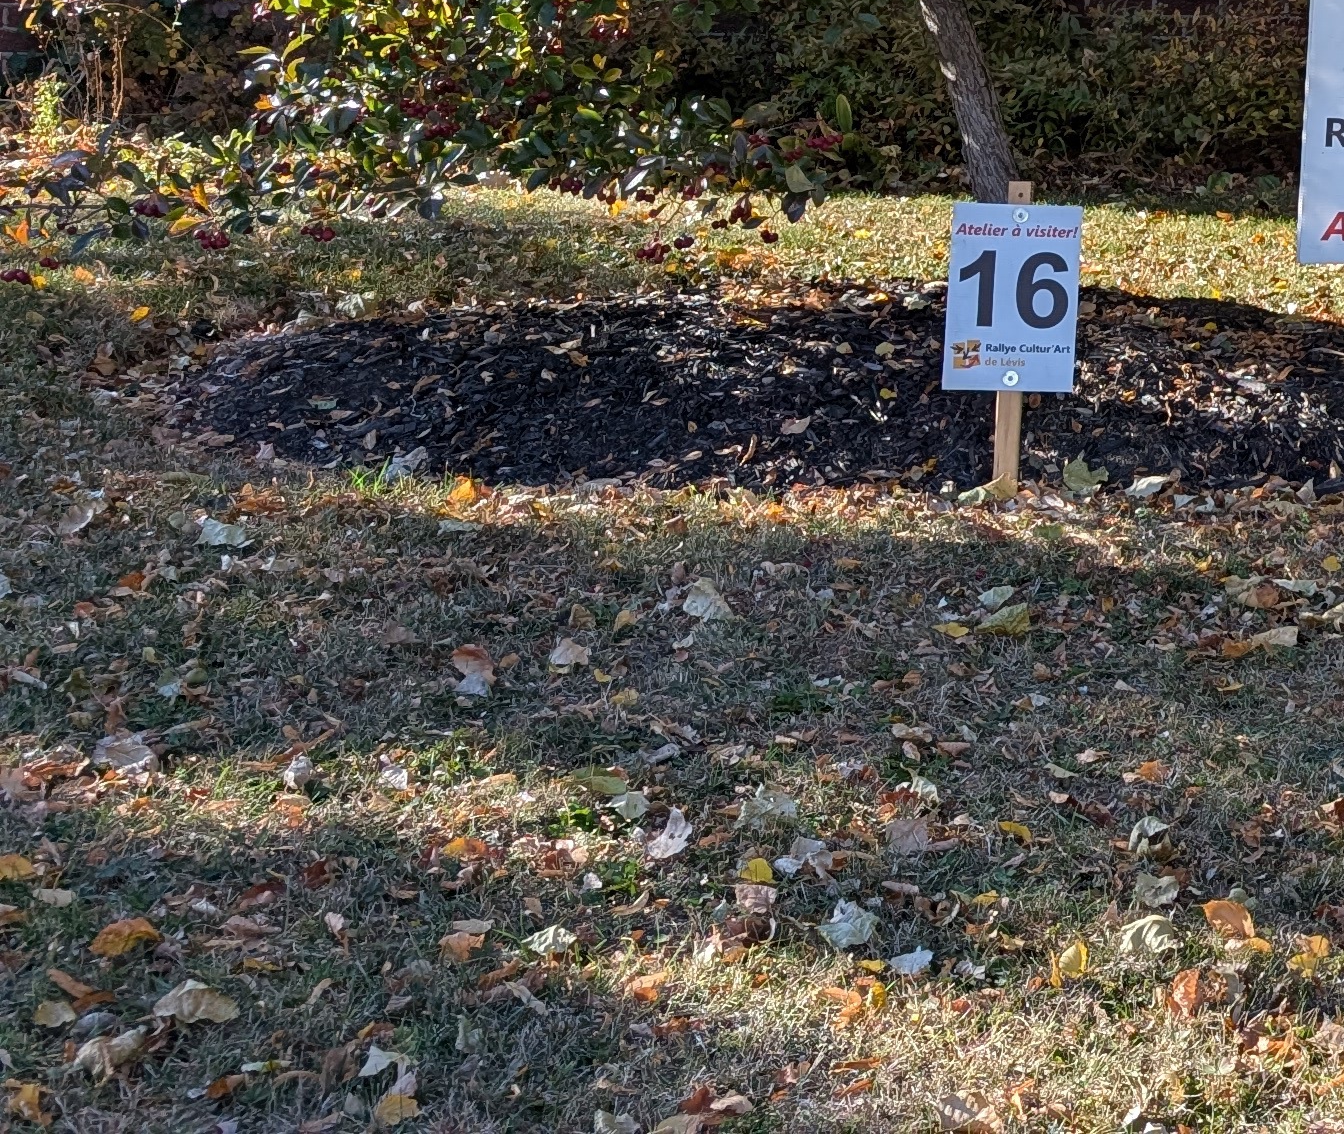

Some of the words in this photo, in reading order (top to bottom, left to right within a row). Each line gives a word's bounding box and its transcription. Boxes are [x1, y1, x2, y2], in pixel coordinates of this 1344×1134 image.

[955, 222, 1008, 237] Atelier
[1011, 223, 1021, 237] à
[1026, 224, 1079, 239] visiter!
[959, 249, 1069, 329] 16
[985, 343, 1017, 354] Rallye
[1019, 344, 1071, 354] Cultur'Art
[984, 356, 998, 366] de
[1000, 357, 1026, 367] Lévis
